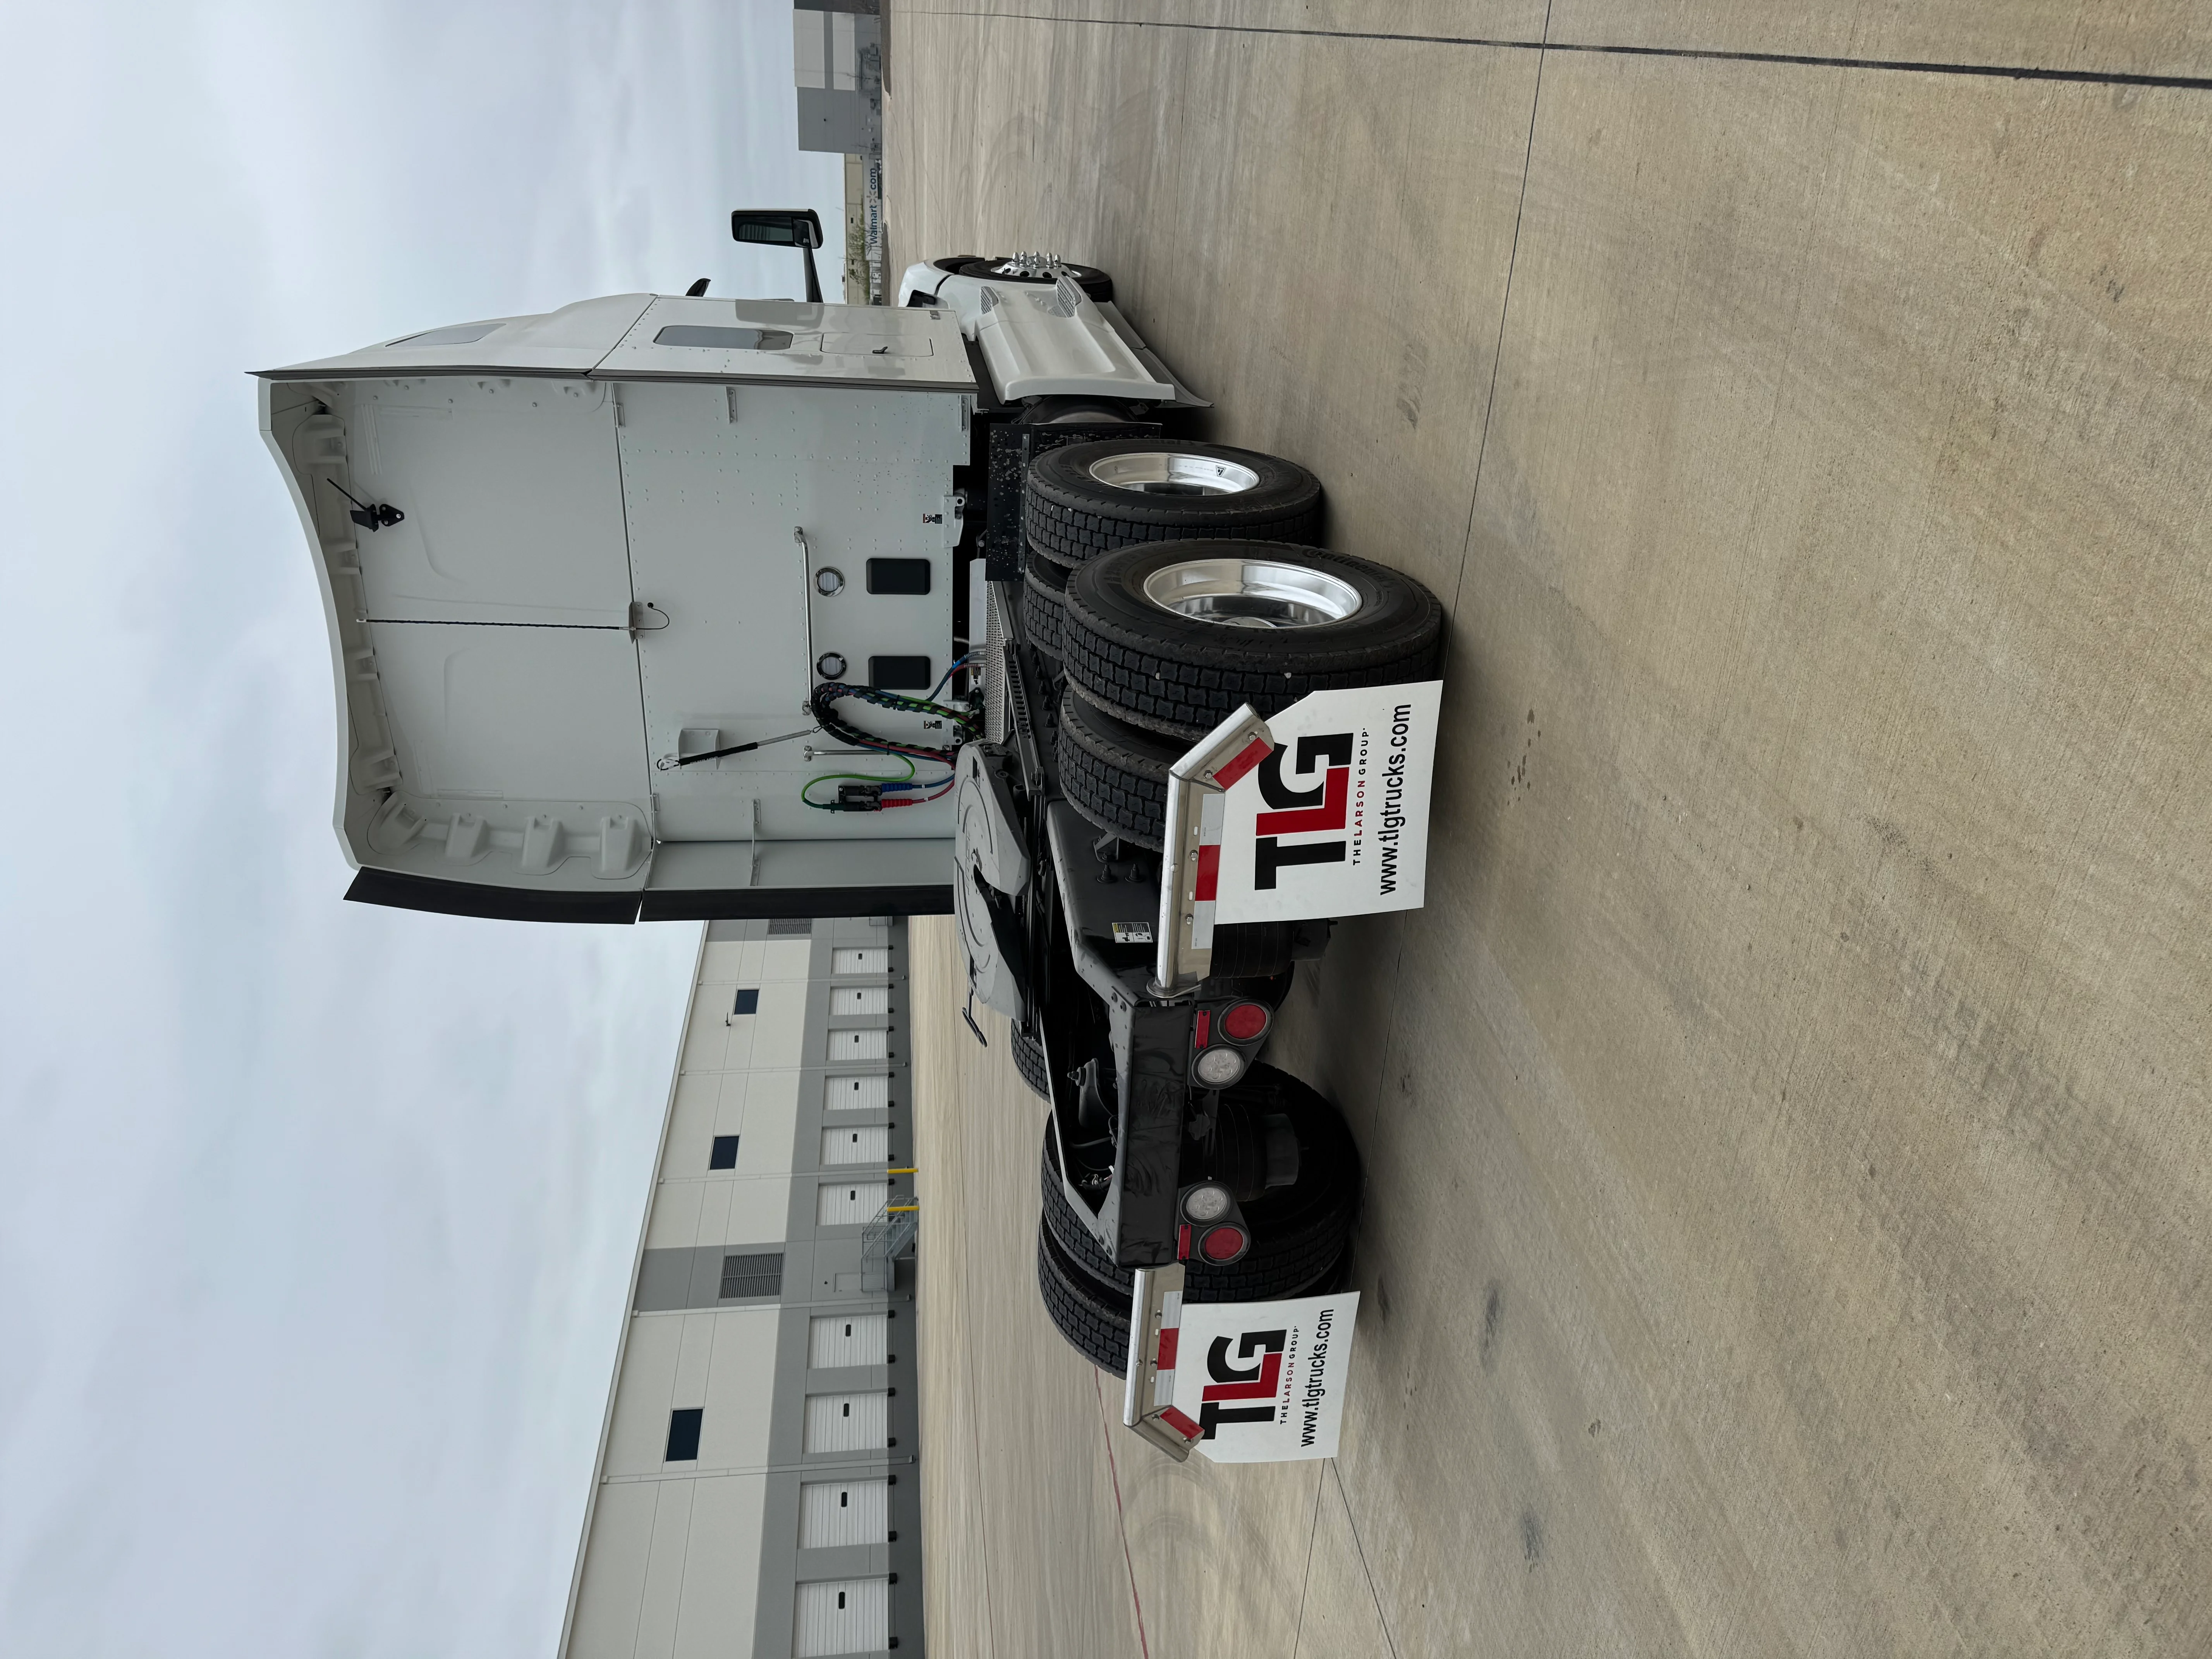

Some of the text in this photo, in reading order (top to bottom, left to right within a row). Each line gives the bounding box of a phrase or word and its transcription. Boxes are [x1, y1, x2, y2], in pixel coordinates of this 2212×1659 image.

[869, 205, 878, 244] Walmart
[1254, 732, 1354, 890] TLG
[1353, 732, 1369, 866] THE LARSON GROUP
[1377, 704, 1412, 896] www.tlgtrucks.com
[1199, 1329, 1287, 1440] TLG
[1280, 1328, 1299, 1425] THE LARSON GROUP
[1301, 1309, 1334, 1447] www.tlgtrucks.com
